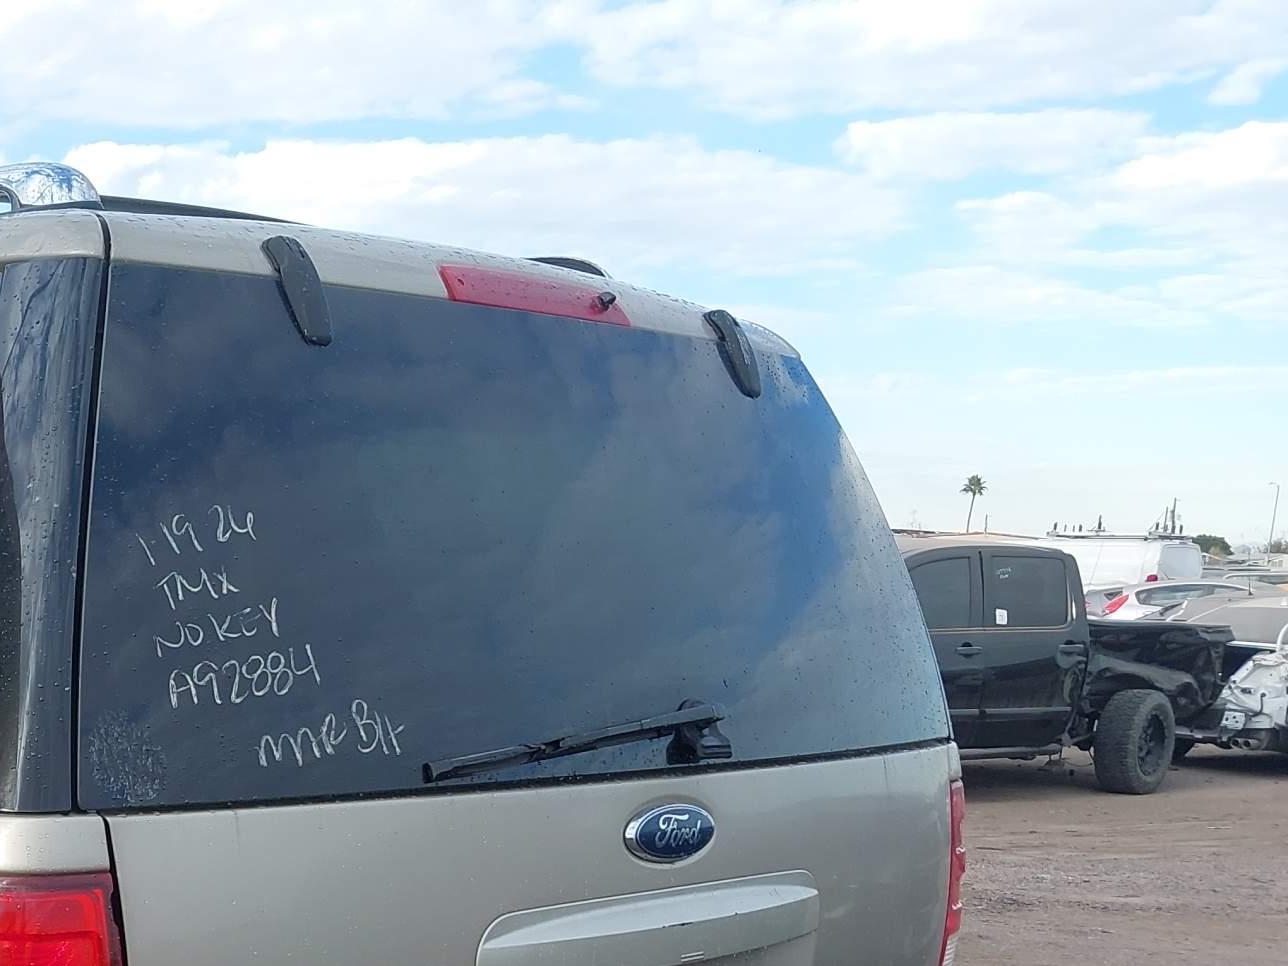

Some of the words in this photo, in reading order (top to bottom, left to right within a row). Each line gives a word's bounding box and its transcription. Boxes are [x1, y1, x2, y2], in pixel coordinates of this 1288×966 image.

[153, 620, 204, 658] NO
[207, 597, 280, 641] KEY
[169, 643, 321, 709] A92884
[655, 813, 702, 849] Ford
